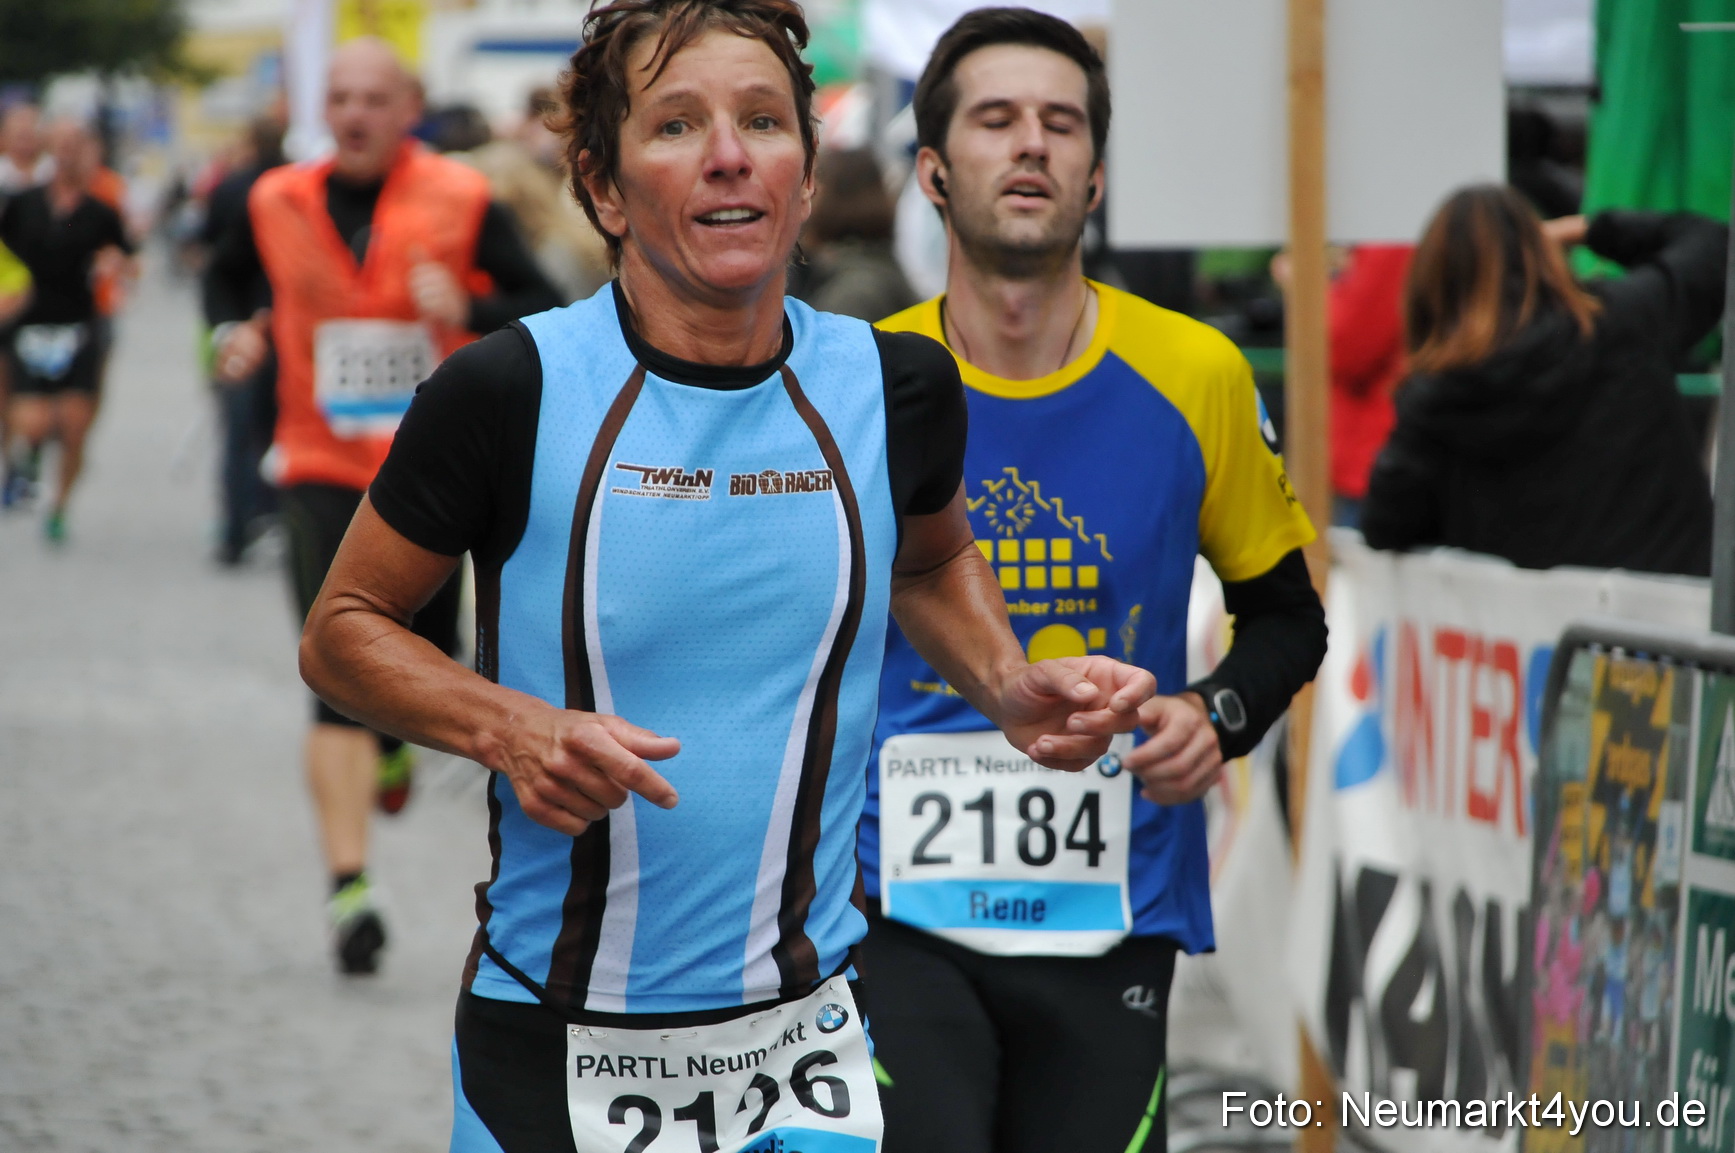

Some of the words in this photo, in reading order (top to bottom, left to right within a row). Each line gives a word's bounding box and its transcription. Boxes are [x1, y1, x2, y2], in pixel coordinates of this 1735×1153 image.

[784, 469, 833, 494] RACER
[1055, 598, 1097, 614] 2014
[887, 757, 968, 778] PARTL
[911, 787, 1106, 868] 2184
[969, 890, 1046, 923] Rene
[576, 1055, 679, 1079] PARTL
[687, 1021, 807, 1077] Neumkt
[607, 1049, 850, 1153] 2126
